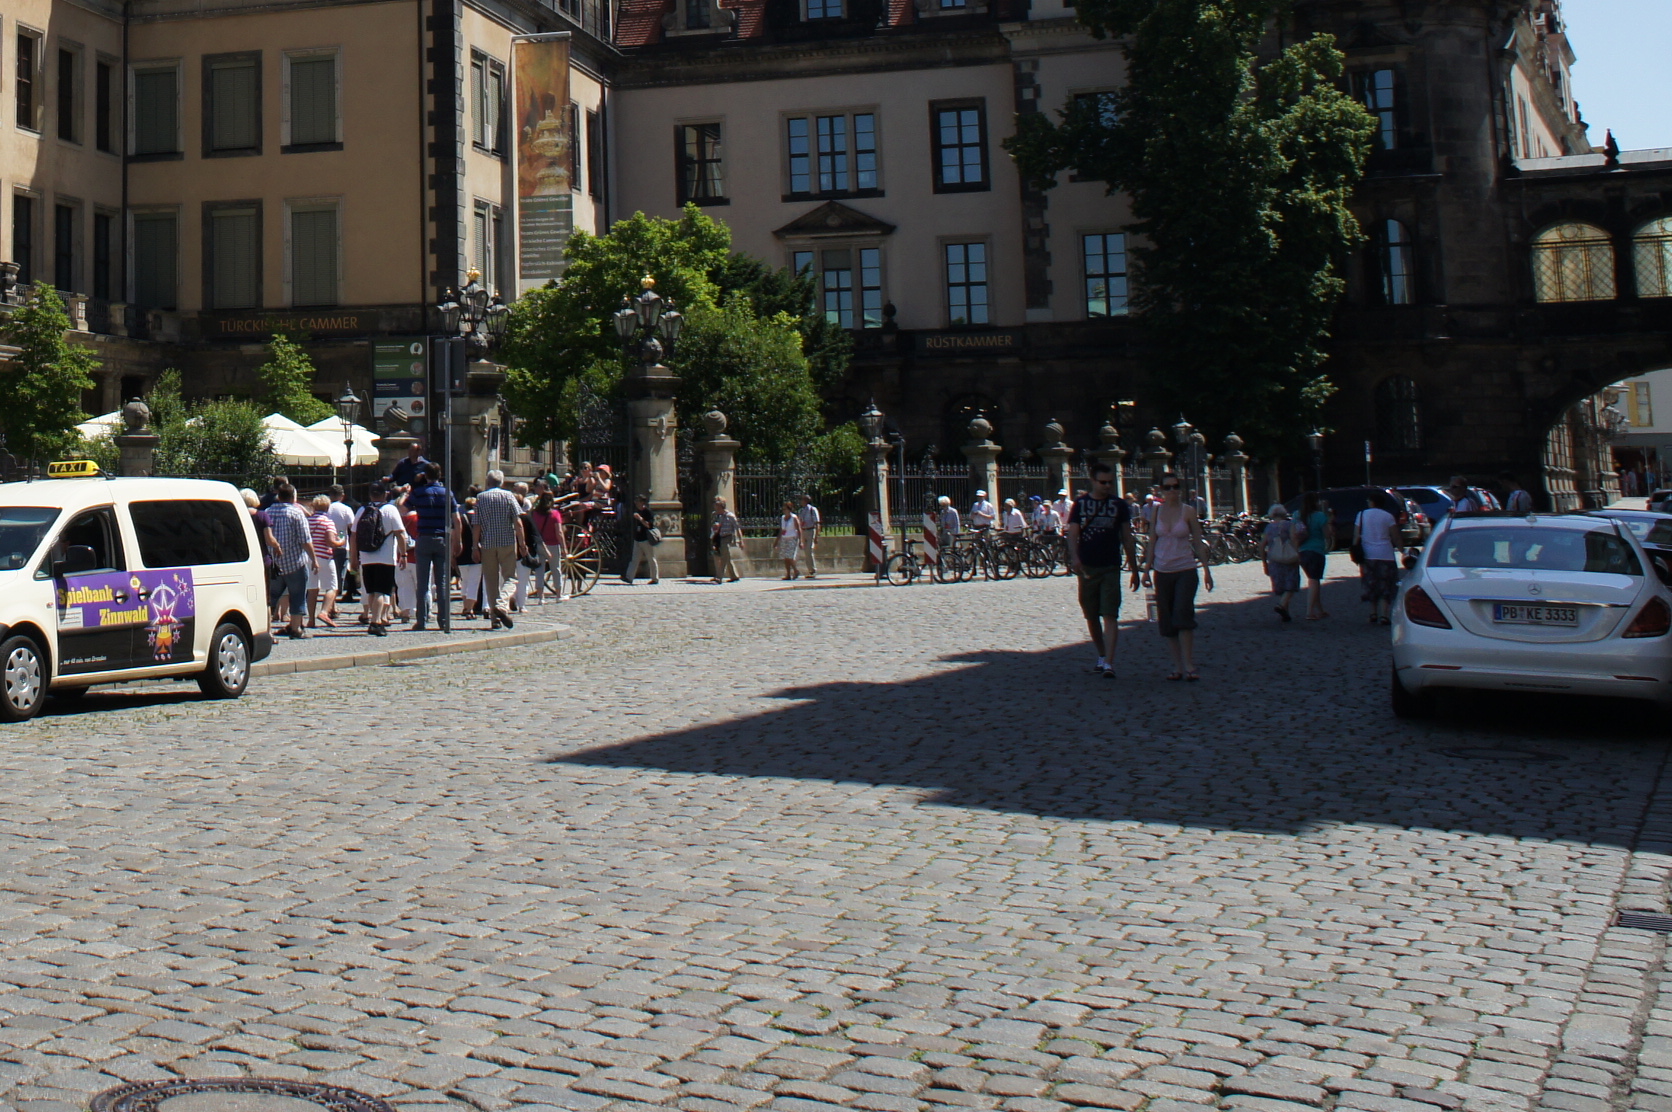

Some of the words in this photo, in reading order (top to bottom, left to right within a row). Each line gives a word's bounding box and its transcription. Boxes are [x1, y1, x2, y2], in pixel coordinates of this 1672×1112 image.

[299, 316, 358, 330] CAMMER
[926, 335, 1013, 348] RÜSTKAMMER
[54, 463, 82, 473] TAXI
[57, 584, 114, 608] Spielbank
[99, 605, 149, 626] Zinnwald
[1502, 606, 1518, 619] PB
[1526, 607, 1542, 620] KE
[1545, 608, 1576, 621] 3333
